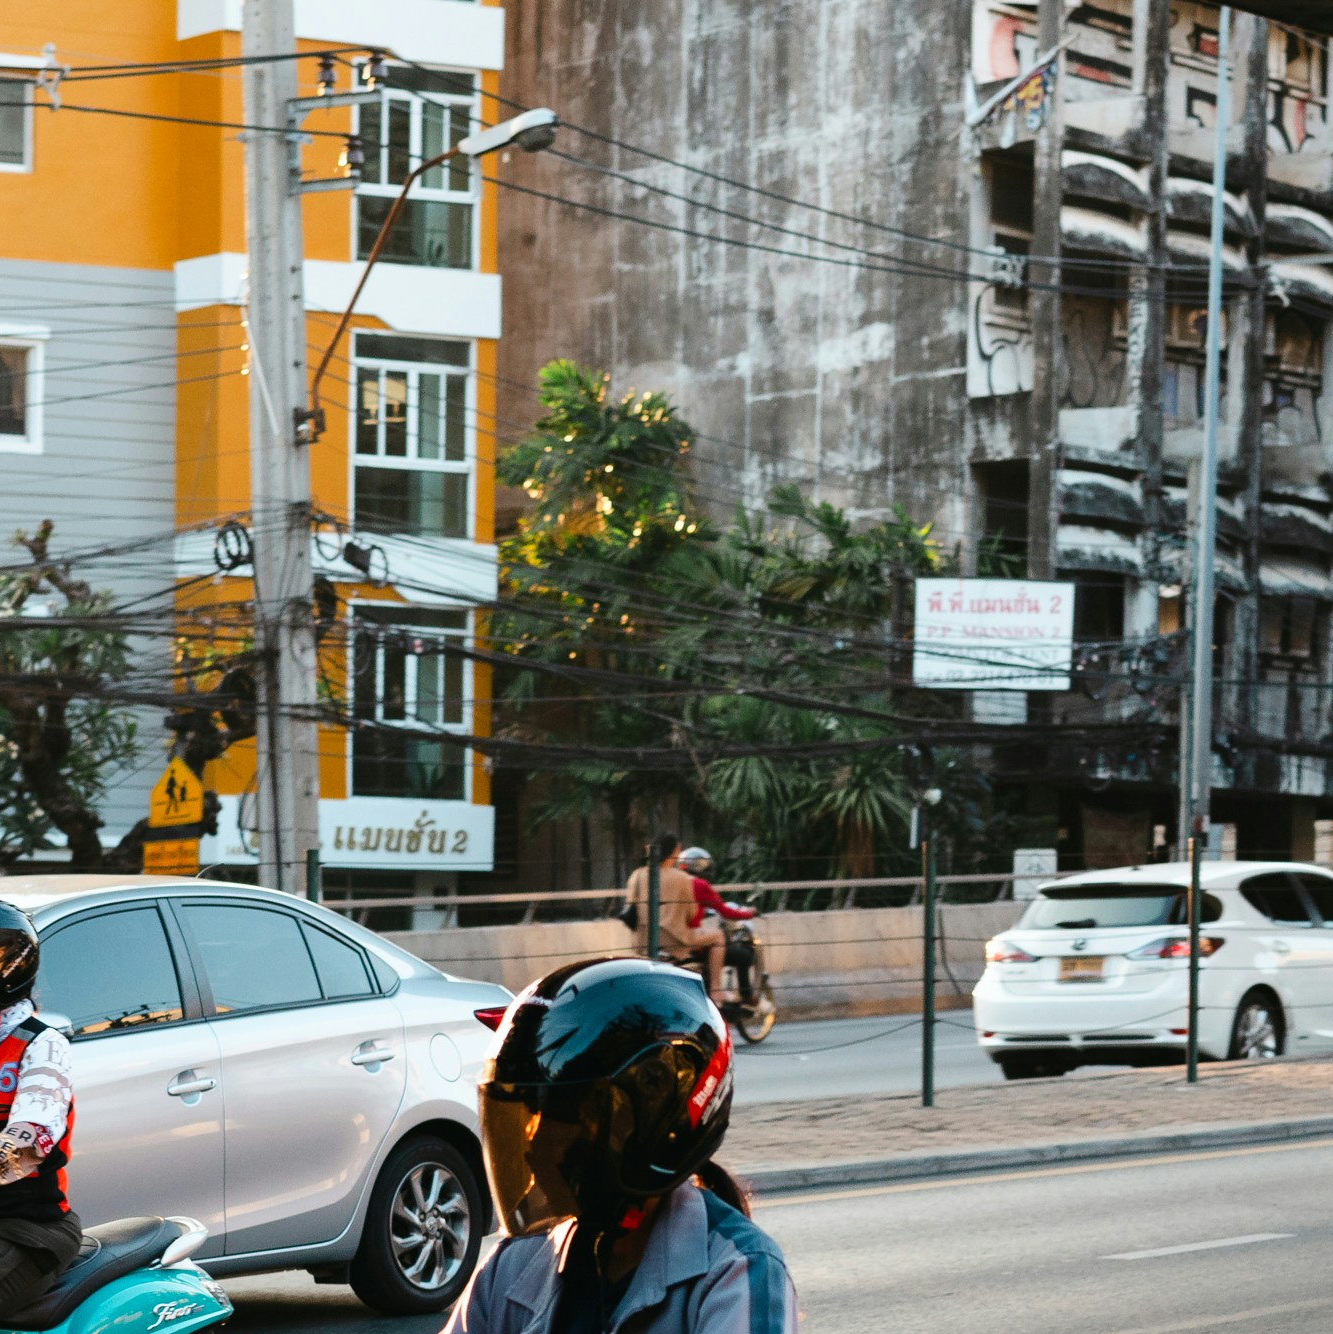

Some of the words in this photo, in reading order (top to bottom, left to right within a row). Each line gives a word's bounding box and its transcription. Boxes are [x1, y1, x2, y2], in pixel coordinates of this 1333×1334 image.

[1049, 594, 1063, 614] 2
[334, 810, 447, 854] แมนชั่น
[451, 829, 468, 854] 2
